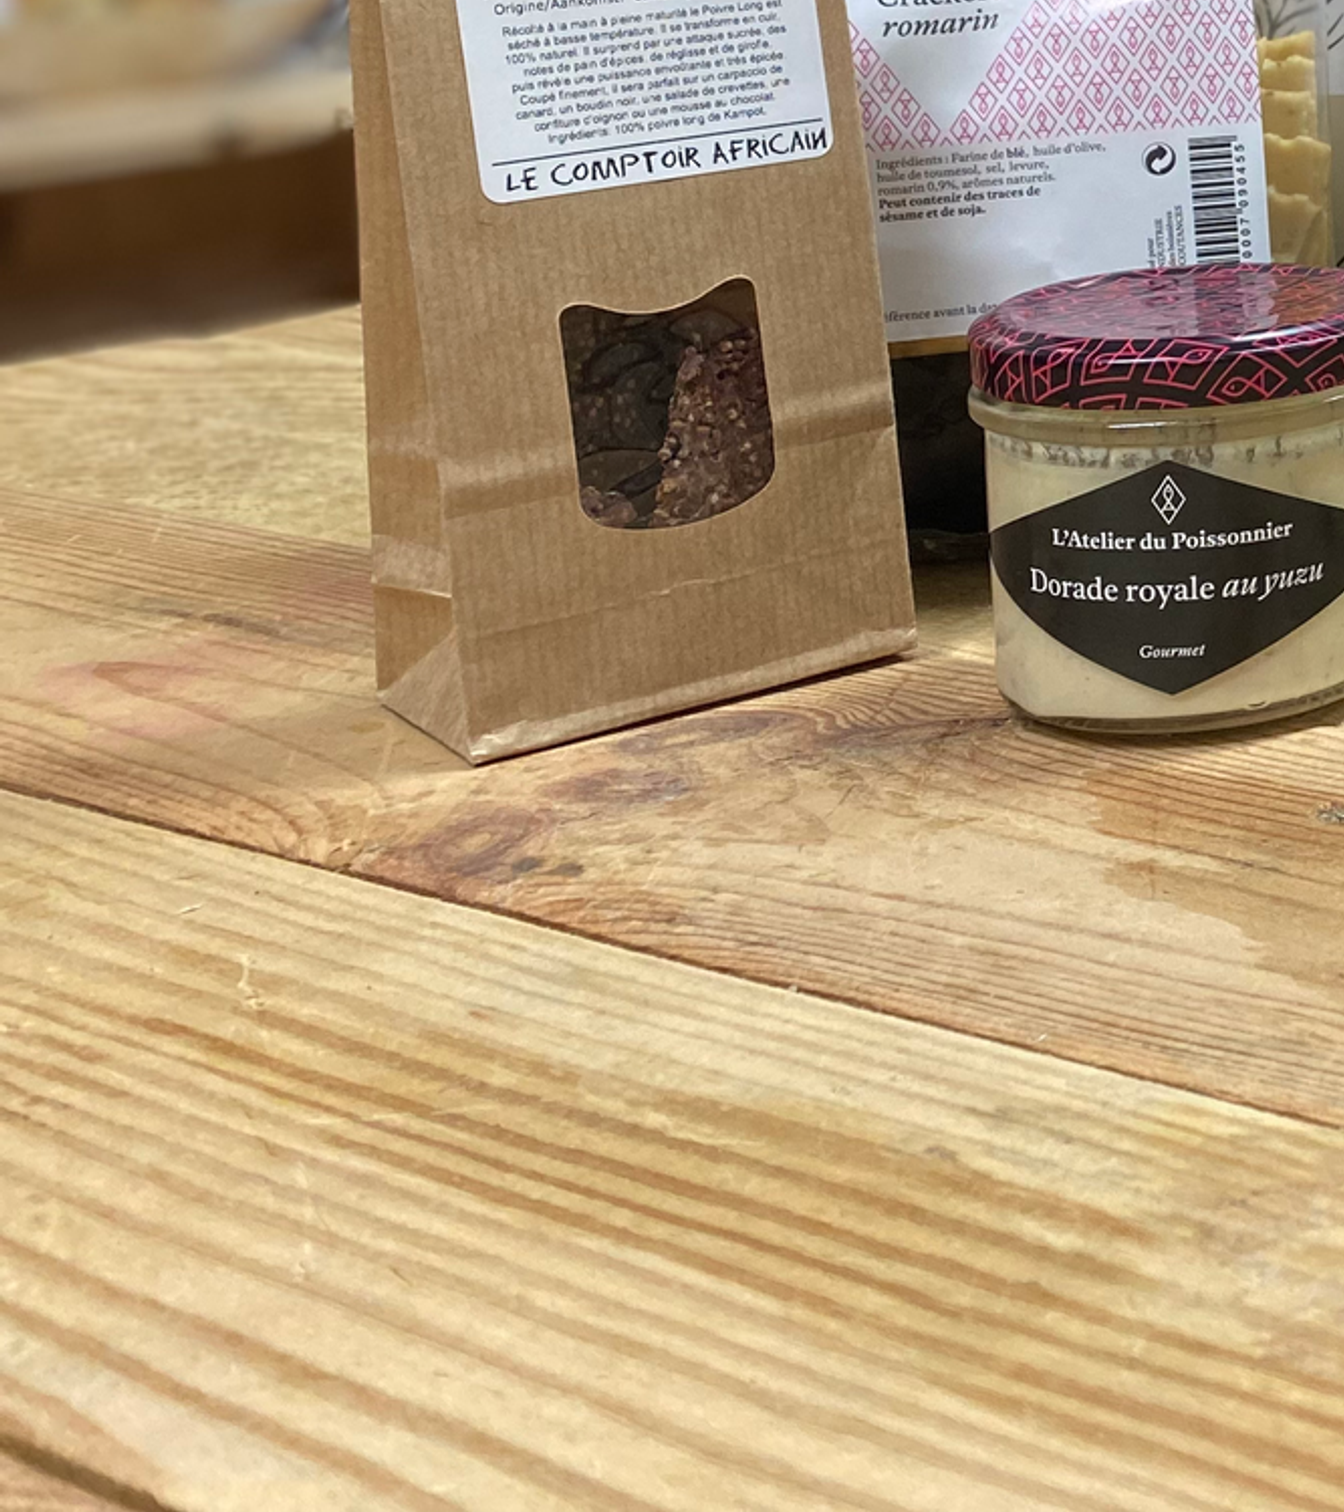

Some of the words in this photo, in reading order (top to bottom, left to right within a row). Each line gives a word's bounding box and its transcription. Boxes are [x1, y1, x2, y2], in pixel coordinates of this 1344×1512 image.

[882, 8, 999, 38] romarin
[990, 150, 1004, 161] de
[506, 167, 539, 192] LE
[964, 190, 984, 202] des
[1026, 185, 1041, 197] de
[940, 206, 955, 218] de
[1051, 527, 1136, 552] L'Atelier
[1139, 531, 1167, 551] du
[1171, 520, 1294, 550] Poissonnier
[1030, 567, 1119, 603] Dorade
[1125, 575, 1216, 610] royale
[1222, 577, 1258, 597] au
[1258, 561, 1325, 601] yuzu
[1138, 642, 1206, 660] Gourmet
